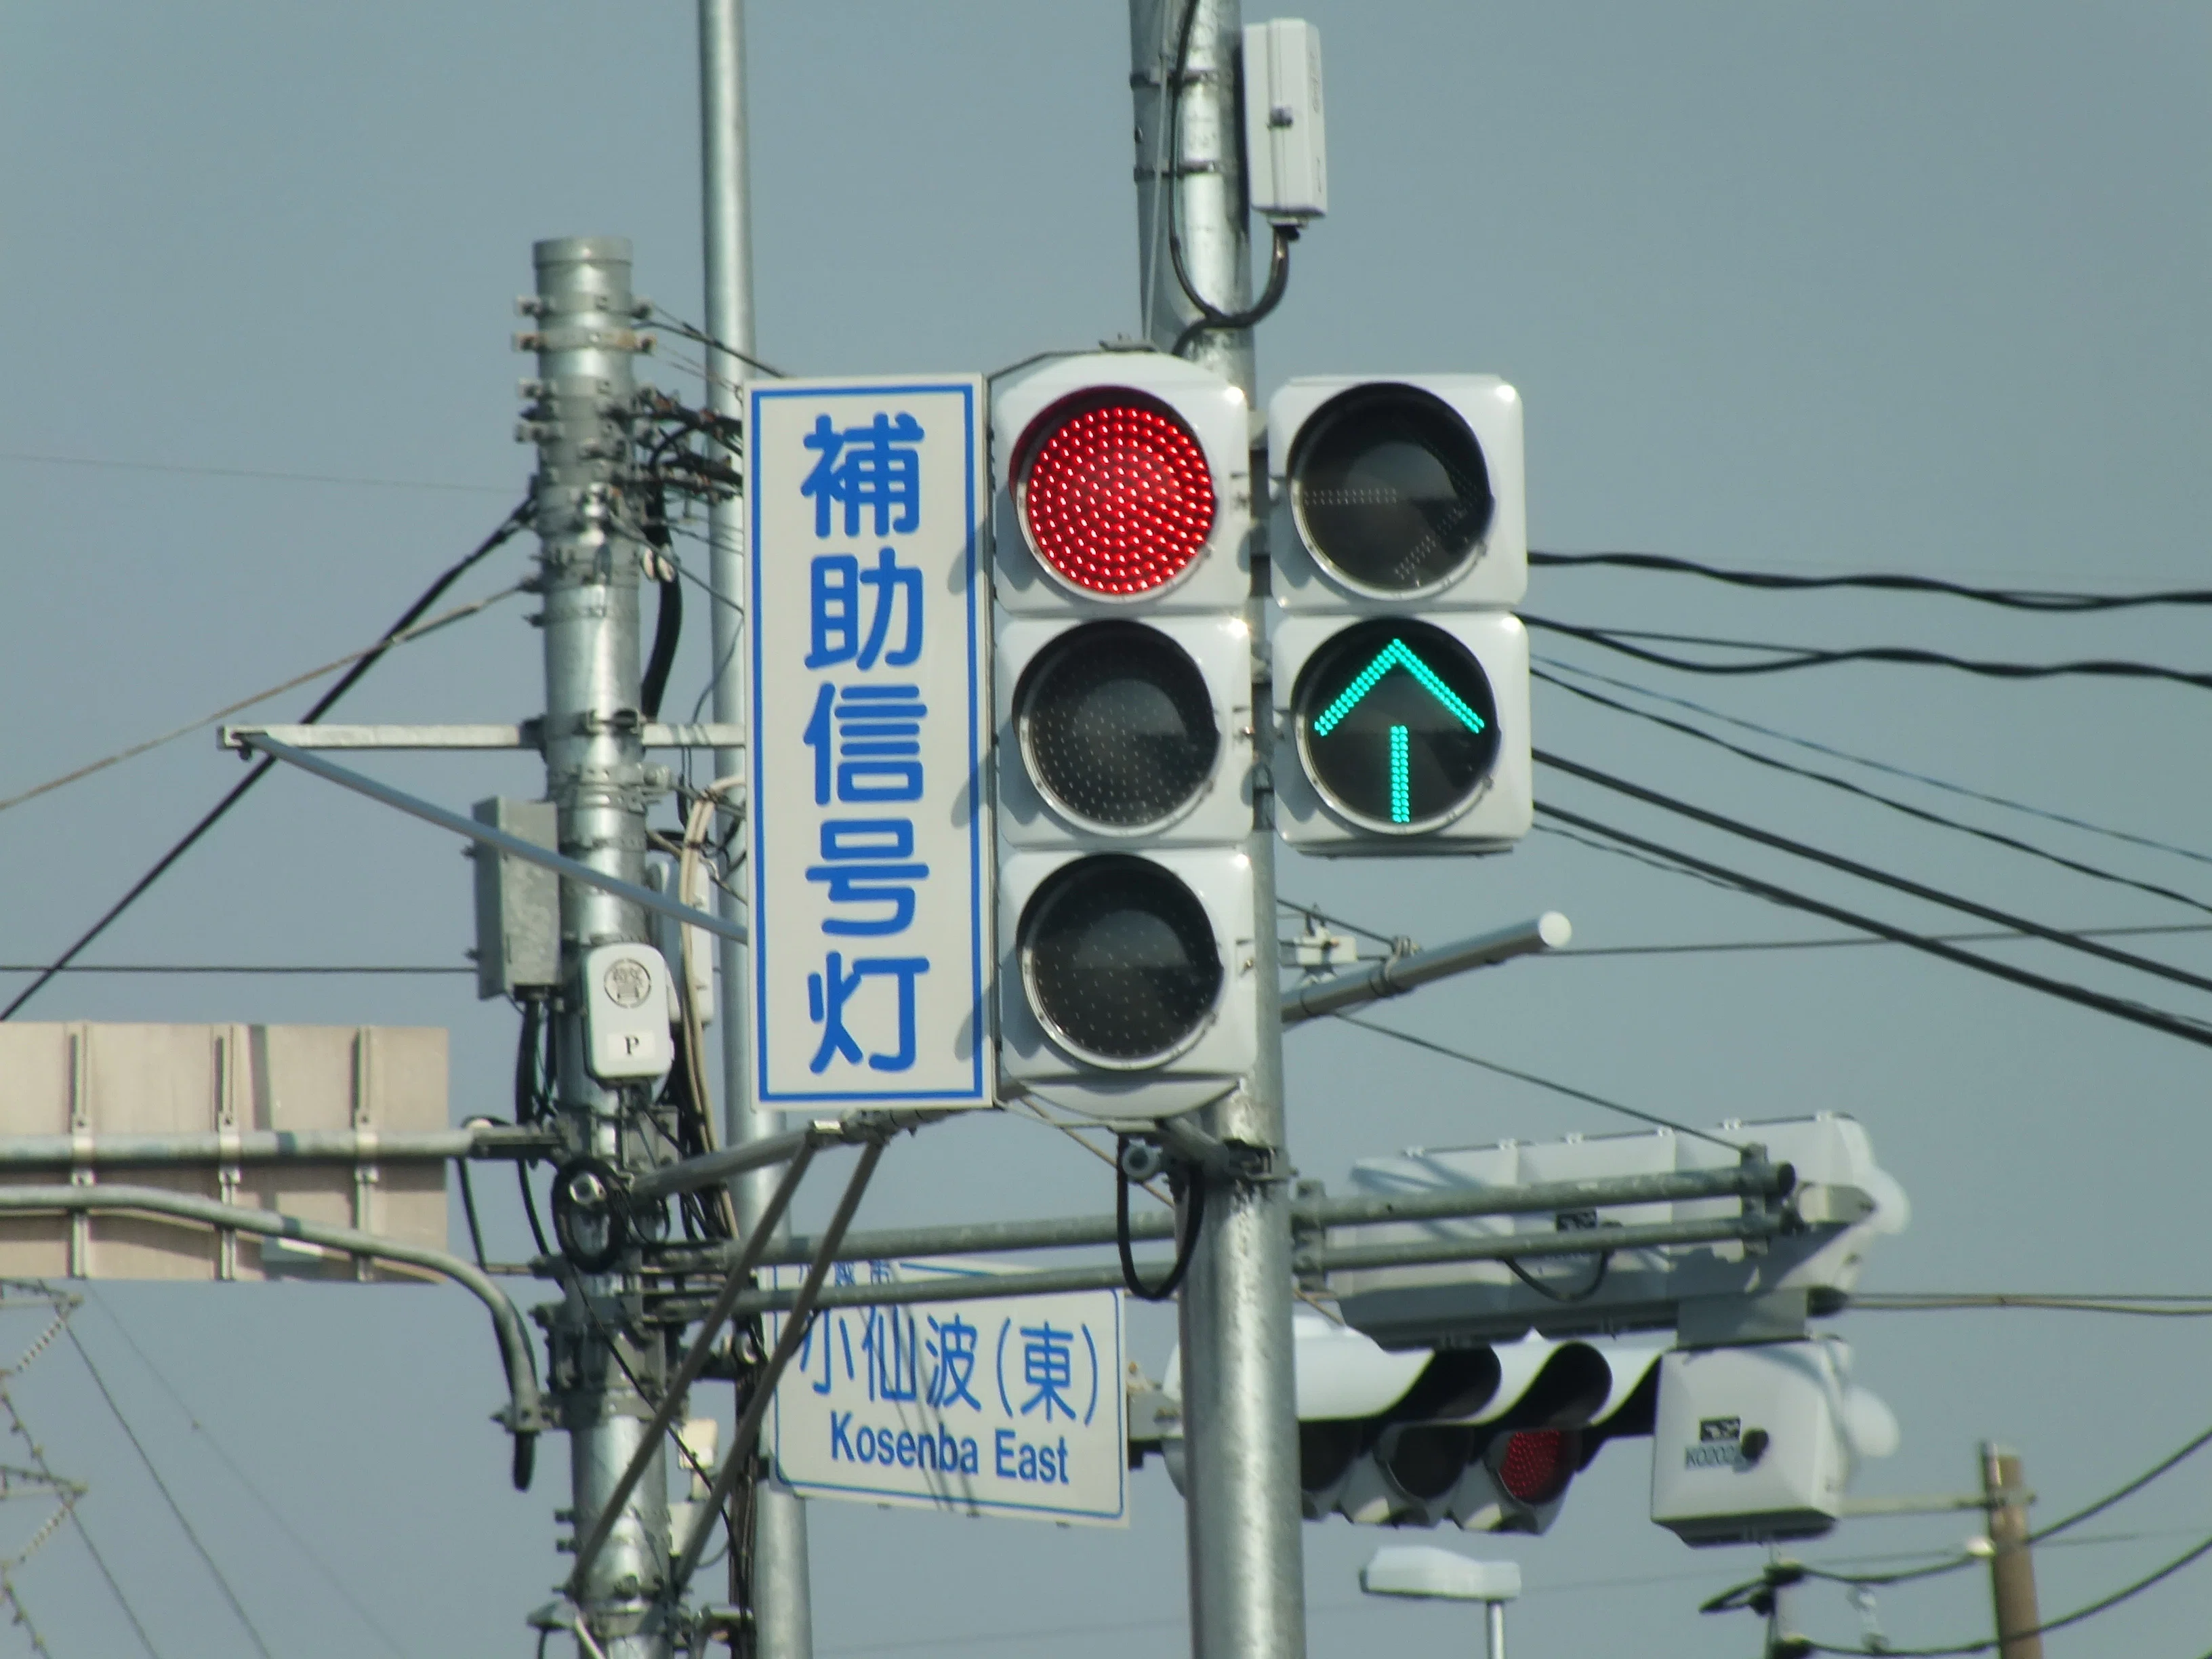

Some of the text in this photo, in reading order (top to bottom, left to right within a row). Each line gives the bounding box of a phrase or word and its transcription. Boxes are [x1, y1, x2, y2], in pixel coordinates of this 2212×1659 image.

[800, 412, 930, 1074] 補助信号灯
[624, 1035, 640, 1056] P
[830, 1410, 1069, 1484] Kosenba East
